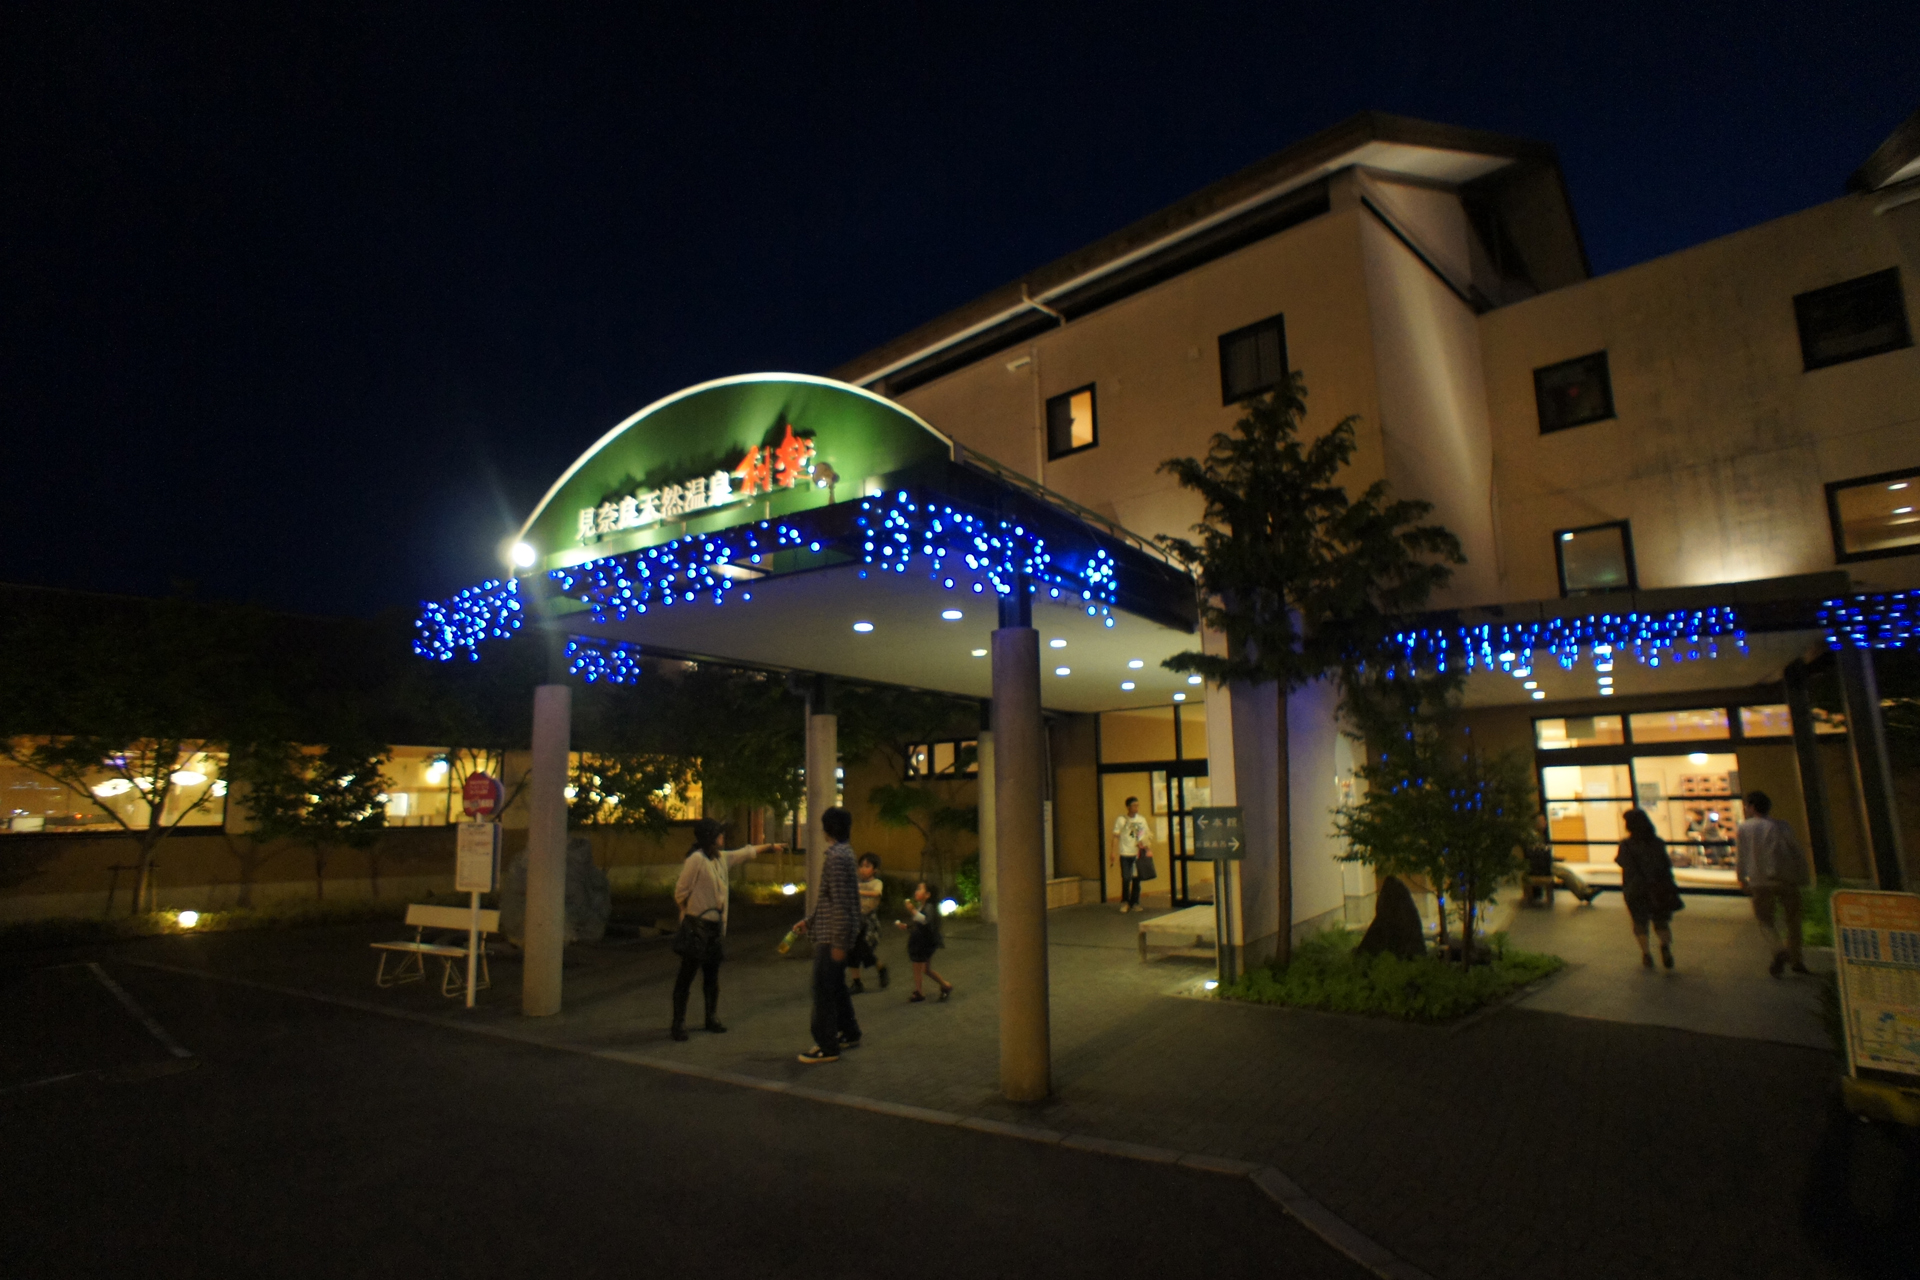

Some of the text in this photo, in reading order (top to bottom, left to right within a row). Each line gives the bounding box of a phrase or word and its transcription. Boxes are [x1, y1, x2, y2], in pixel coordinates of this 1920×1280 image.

[577, 470, 733, 540] 見奈良天然温泉
